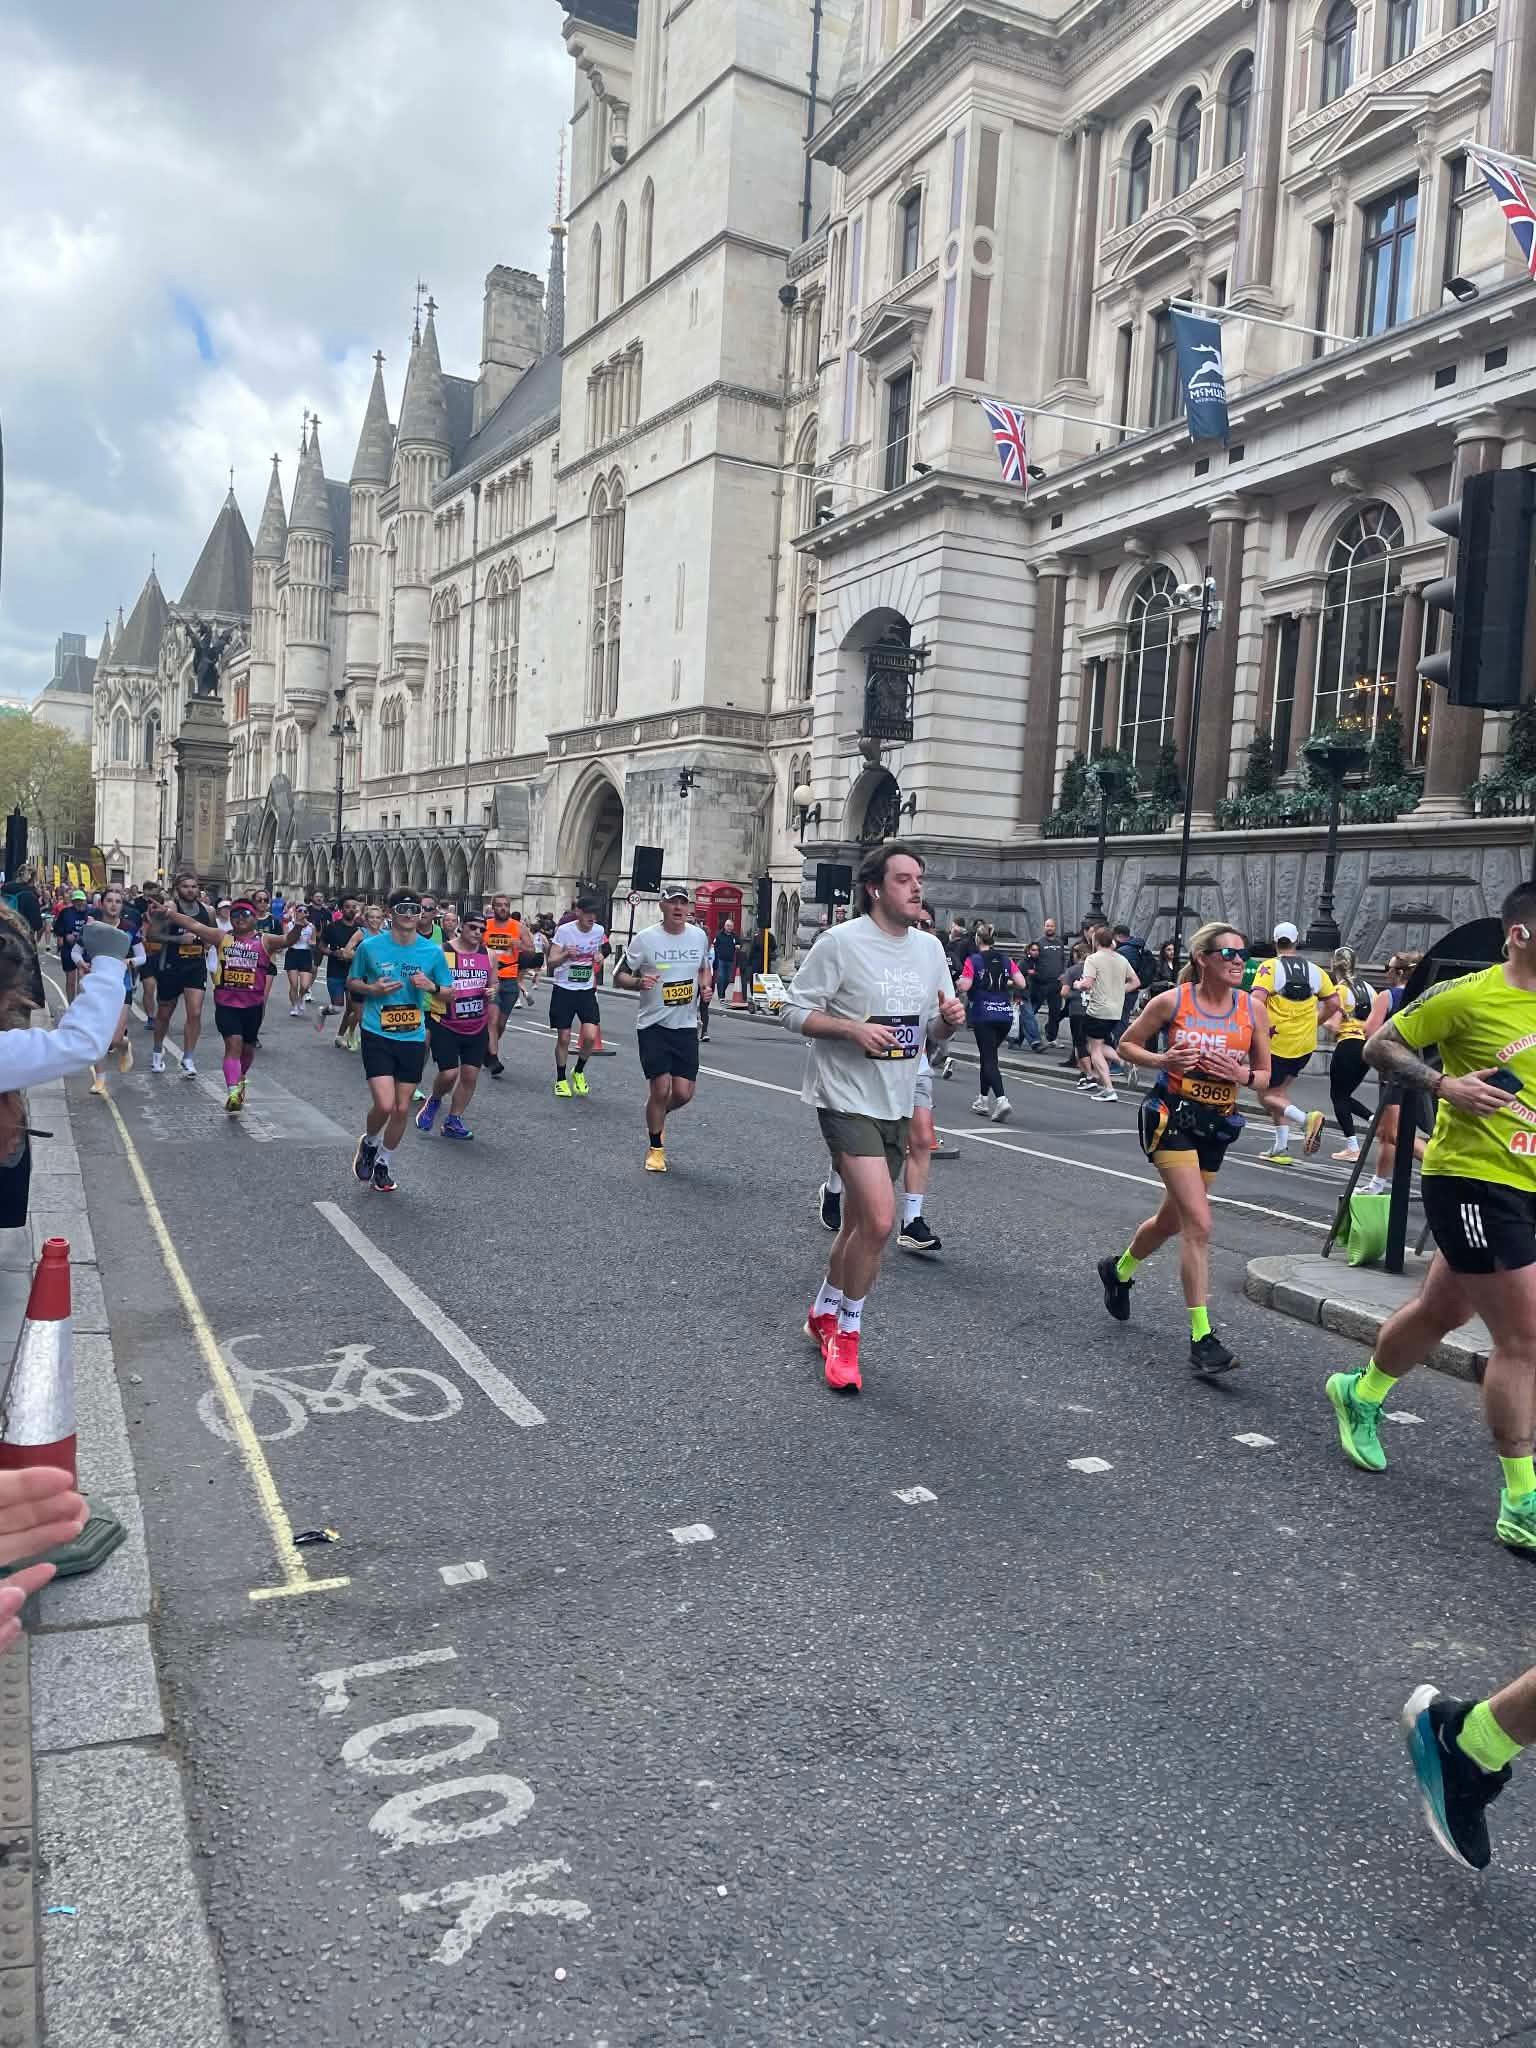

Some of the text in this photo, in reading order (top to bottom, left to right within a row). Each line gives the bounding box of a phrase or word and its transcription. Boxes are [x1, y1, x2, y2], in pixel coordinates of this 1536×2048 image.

[655, 949, 699, 960] NIKE
[884, 967, 920, 983] Nike
[874, 982, 929, 998] Track
[886, 998, 920, 1013] Club
[388, 1011, 415, 1023] 3003
[894, 1028, 914, 1044] 20
[1175, 1030, 1228, 1048] BONE
[1190, 1083, 1231, 1101] 3969
[309, 1646, 592, 1967] LOOK
